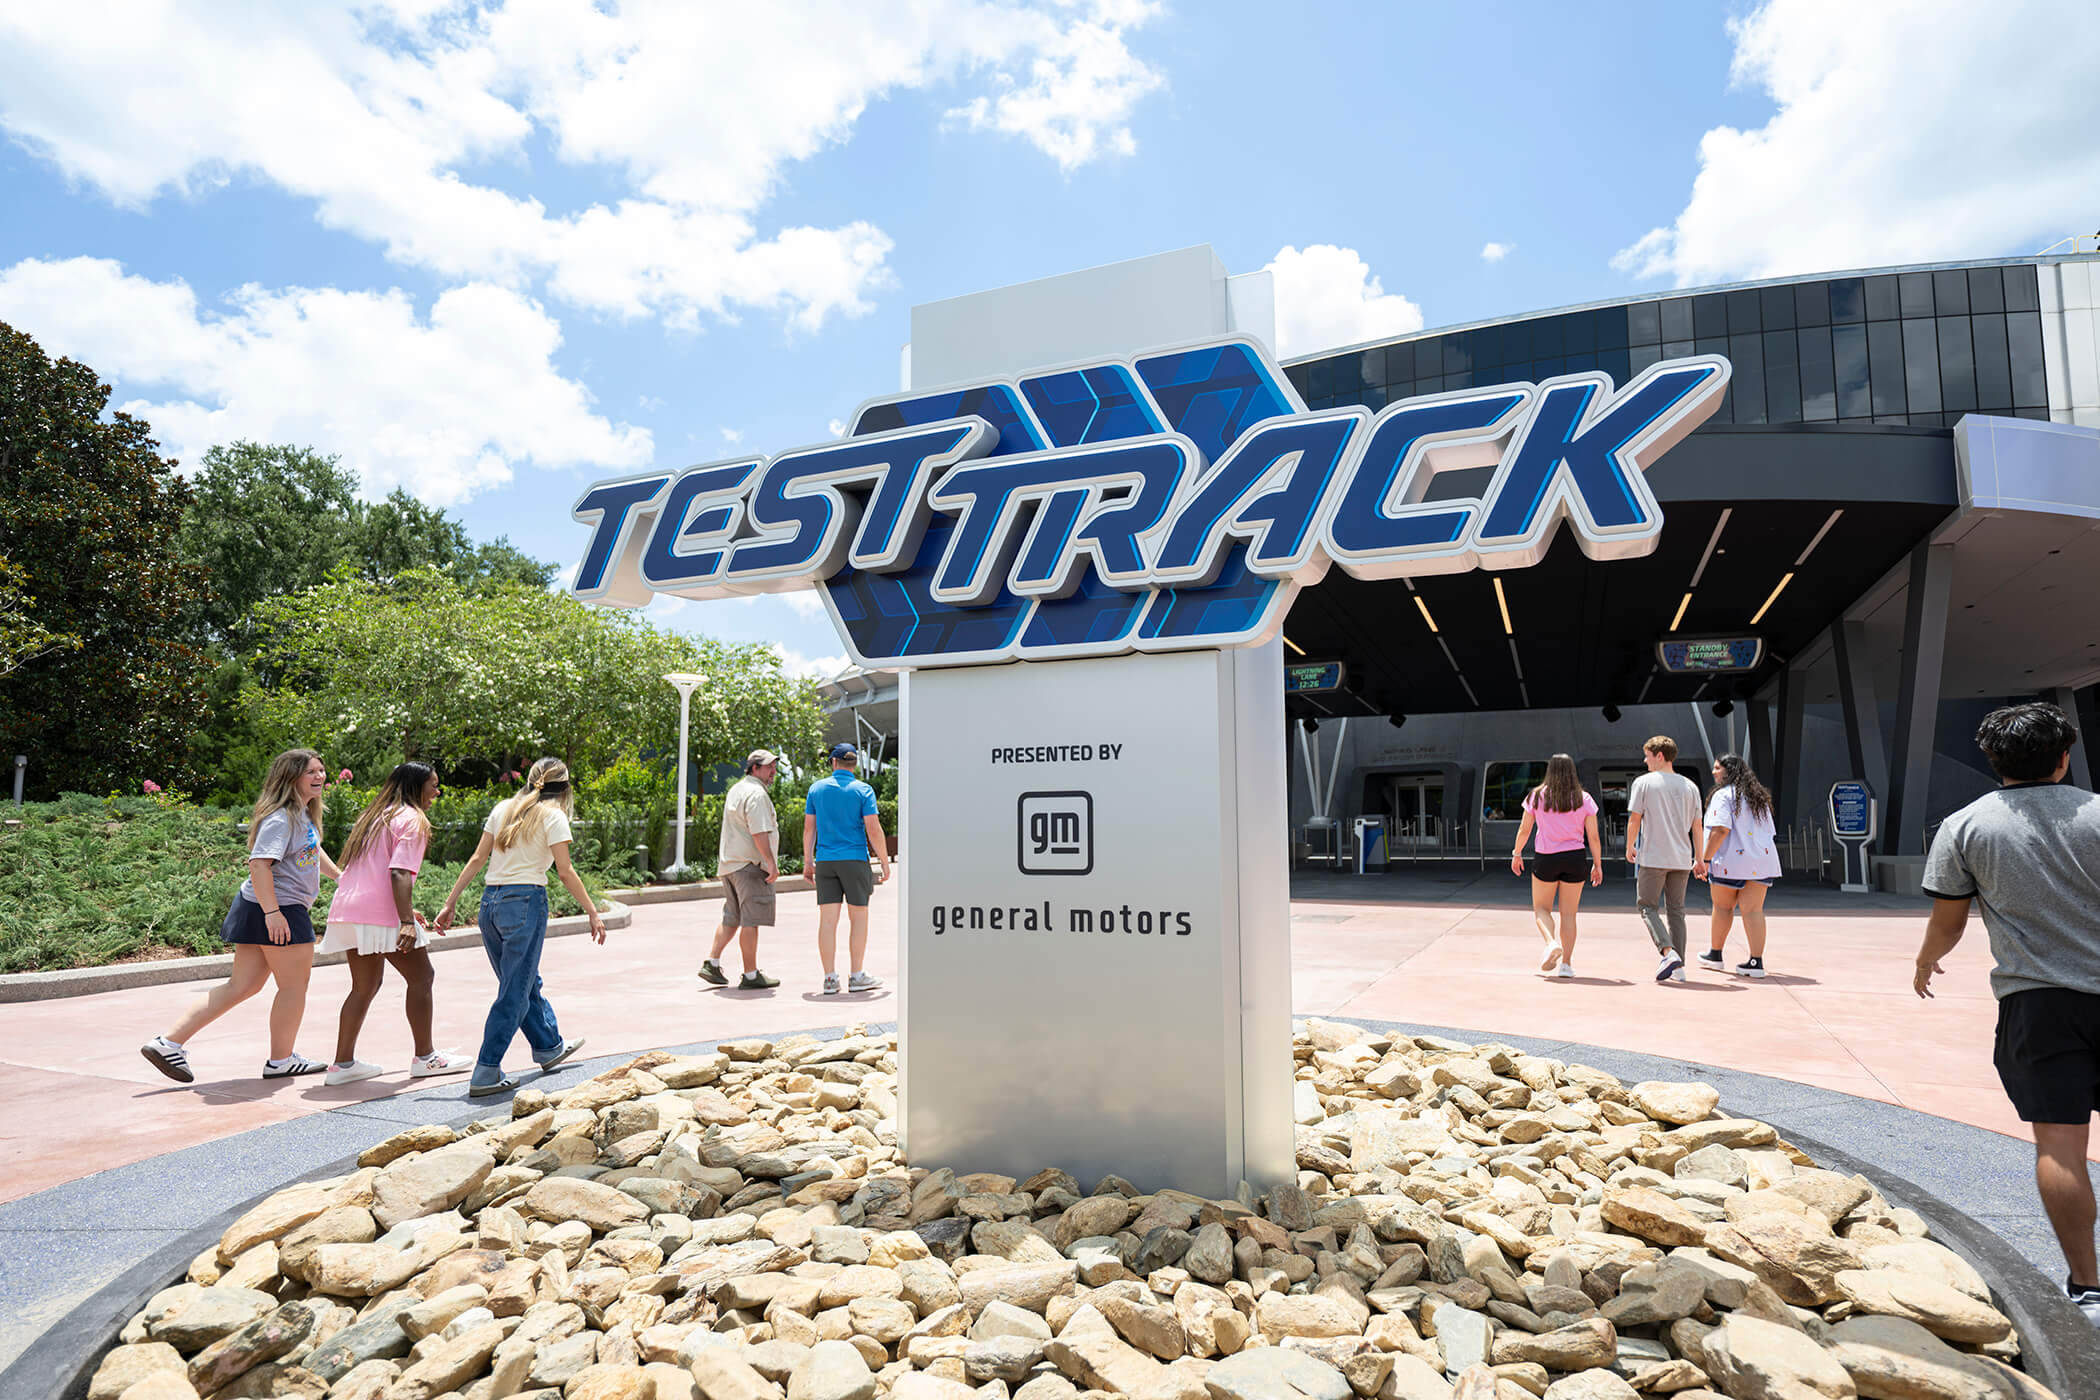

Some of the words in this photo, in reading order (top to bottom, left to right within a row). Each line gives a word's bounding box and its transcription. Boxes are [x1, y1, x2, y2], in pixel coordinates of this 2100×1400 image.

[573, 416, 989, 600] TEST
[930, 355, 1731, 600] TRACK
[1689, 644, 1728, 652] STANDBY
[992, 744, 1092, 764] PRESENTED
[1099, 743, 1122, 760] BY
[1030, 812, 1080, 854] gm
[932, 901, 1053, 935] general
[1070, 905, 1192, 935] motors
